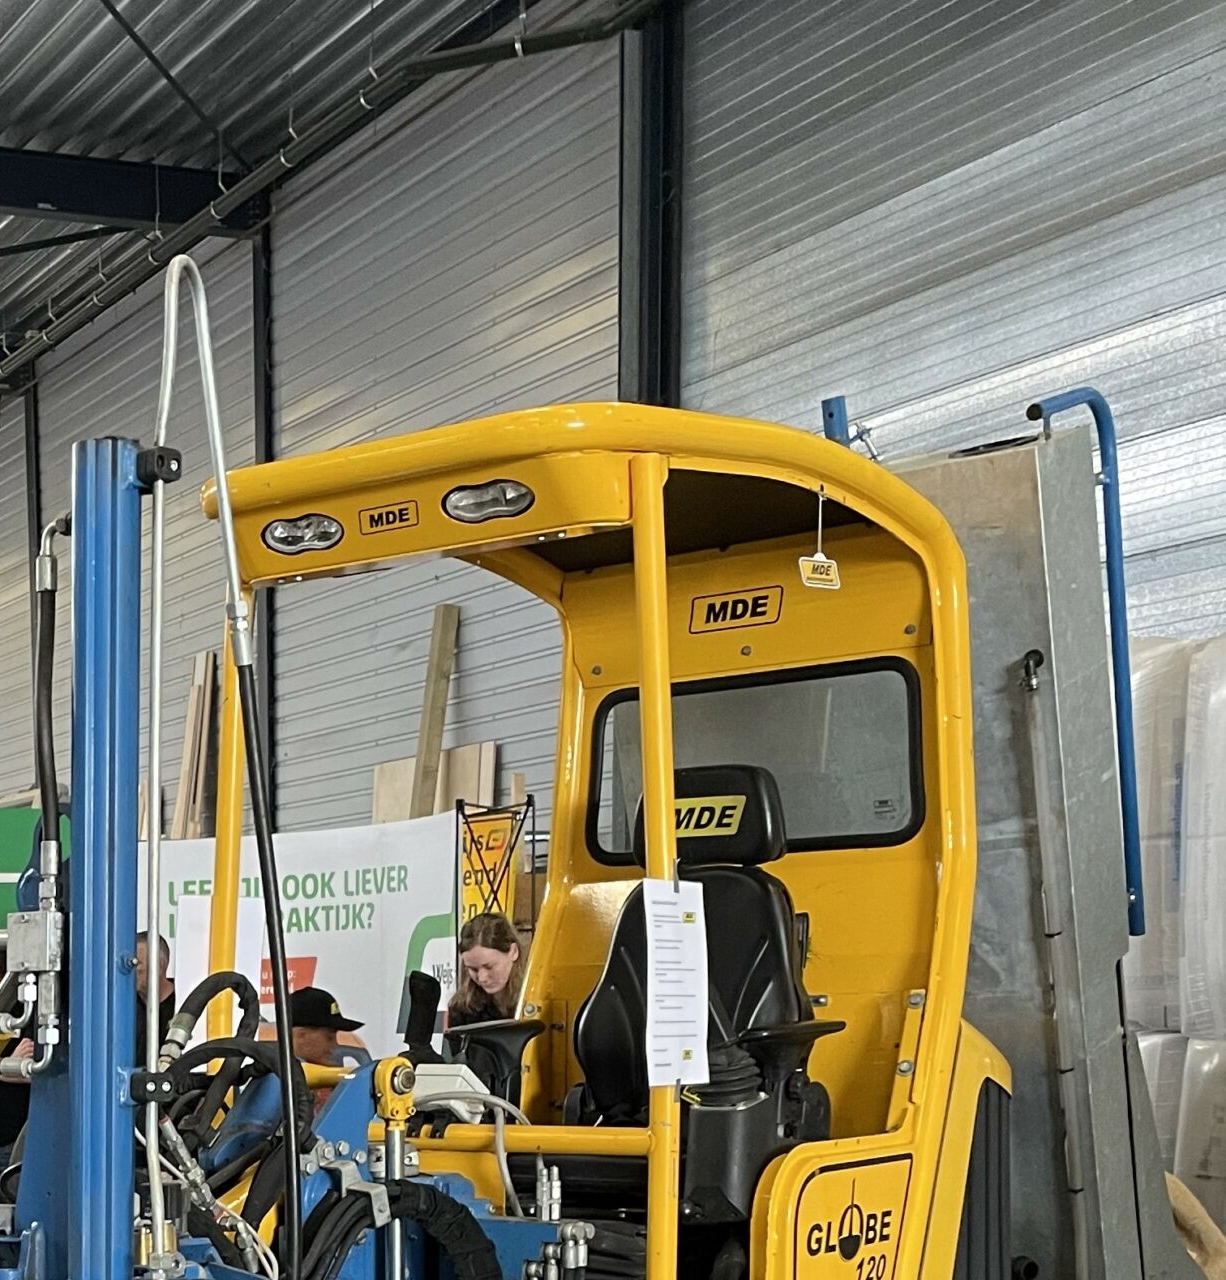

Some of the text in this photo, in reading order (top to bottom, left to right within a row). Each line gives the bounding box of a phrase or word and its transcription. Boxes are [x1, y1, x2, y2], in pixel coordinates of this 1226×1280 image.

[369, 508, 410, 528] MDE
[811, 563, 832, 576] MDE
[705, 595, 769, 624] MDE
[674, 805, 737, 830] MDE
[282, 871, 336, 900] OOK
[344, 865, 408, 897] LIEVER
[285, 902, 374, 933] AKTIJK?
[807, 1203, 892, 1260] GLOBE
